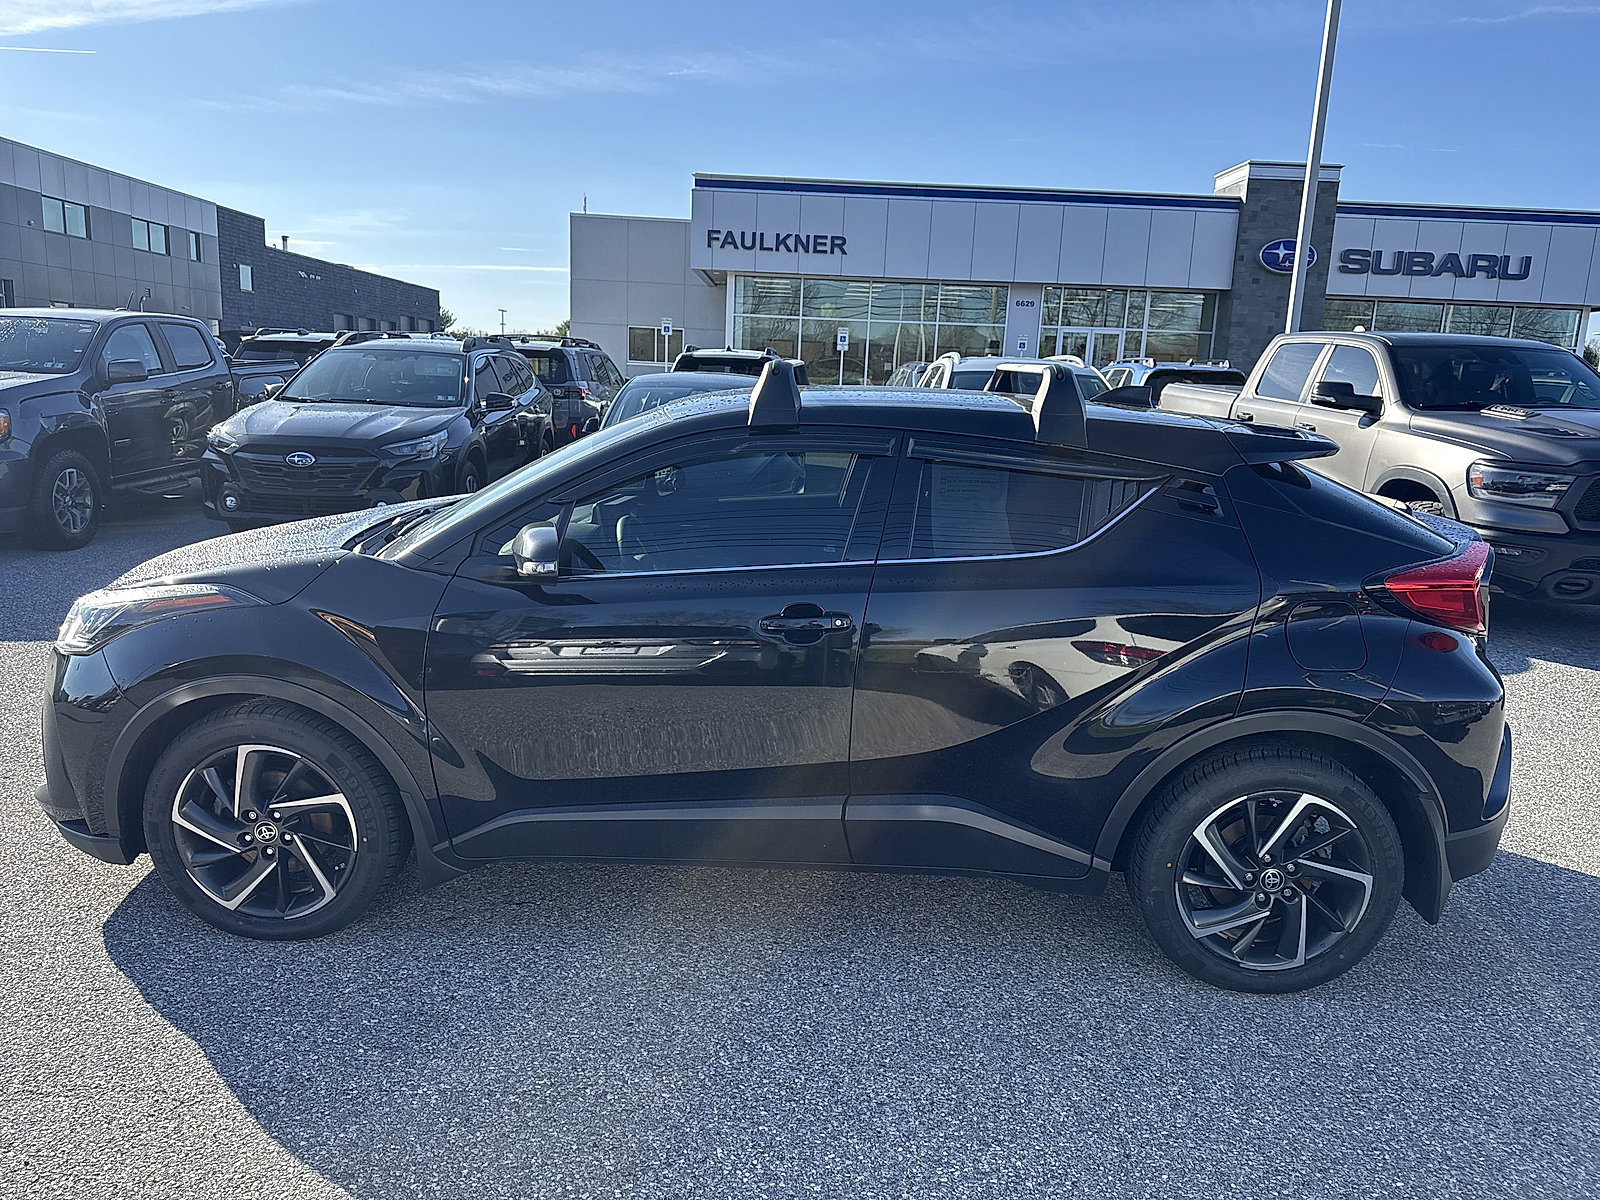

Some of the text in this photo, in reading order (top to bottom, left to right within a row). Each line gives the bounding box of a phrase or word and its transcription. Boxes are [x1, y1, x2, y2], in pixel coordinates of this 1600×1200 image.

[707, 229, 848, 255] FAULKNER
[1338, 248, 1532, 281] SUBARU
[1015, 299, 1035, 308] 6629
[337, 766, 379, 842] ADVANTA
